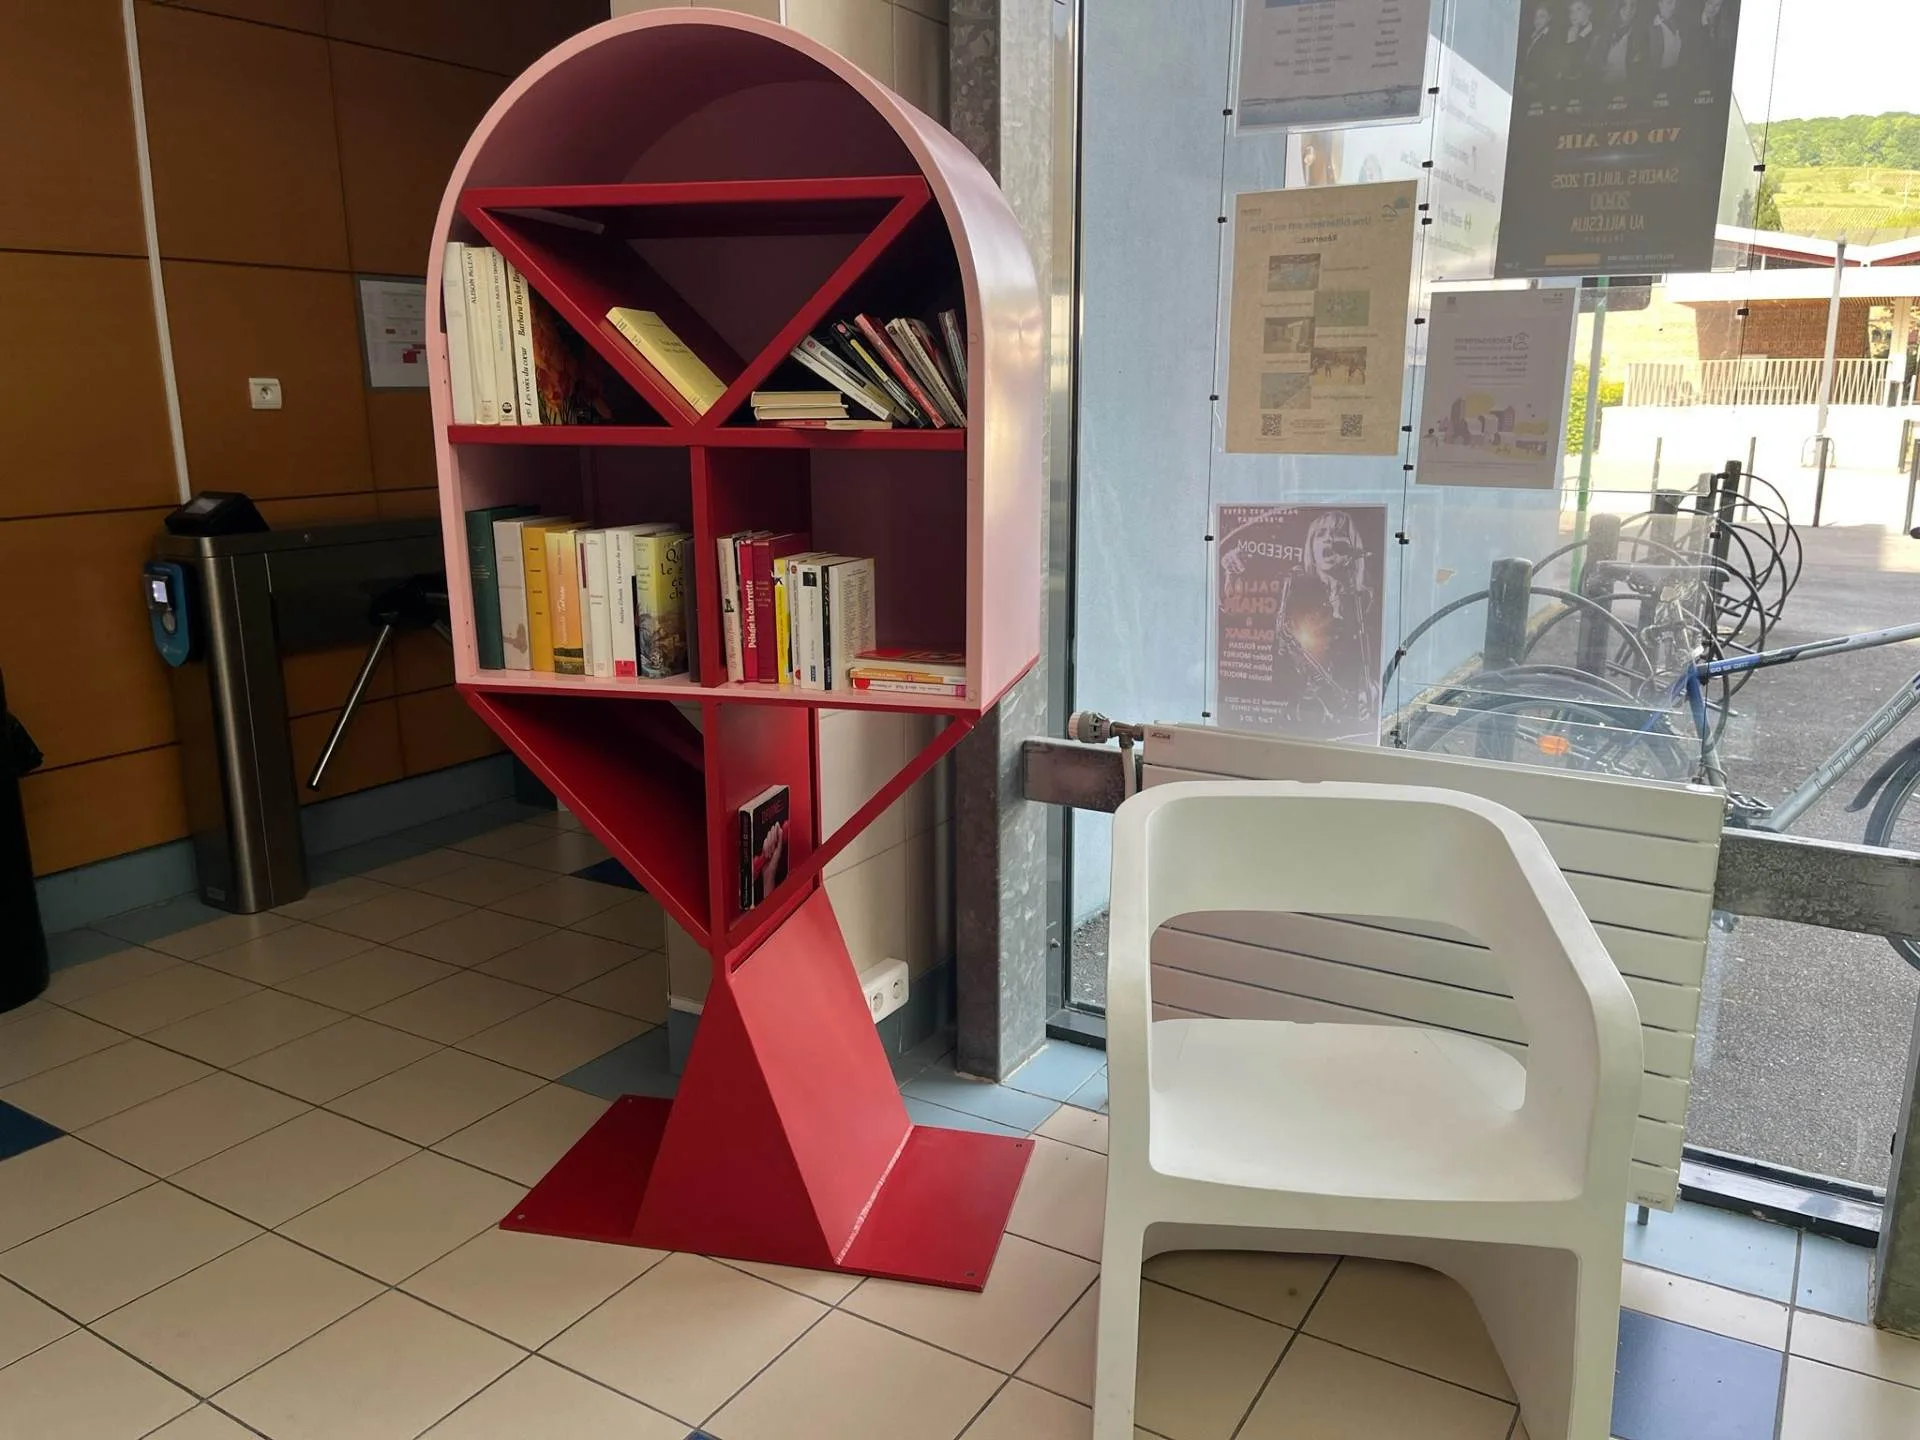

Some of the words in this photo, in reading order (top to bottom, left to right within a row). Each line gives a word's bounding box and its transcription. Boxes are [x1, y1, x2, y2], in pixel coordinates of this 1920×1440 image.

[468, 279, 477, 304] ALISON
[513, 284, 524, 305] Taylor
[515, 306, 526, 337] Barbara
[521, 367, 529, 377] du
[522, 378, 531, 392] voix
[744, 580, 755, 614] charrette
[746, 623, 757, 649] Pélagie
